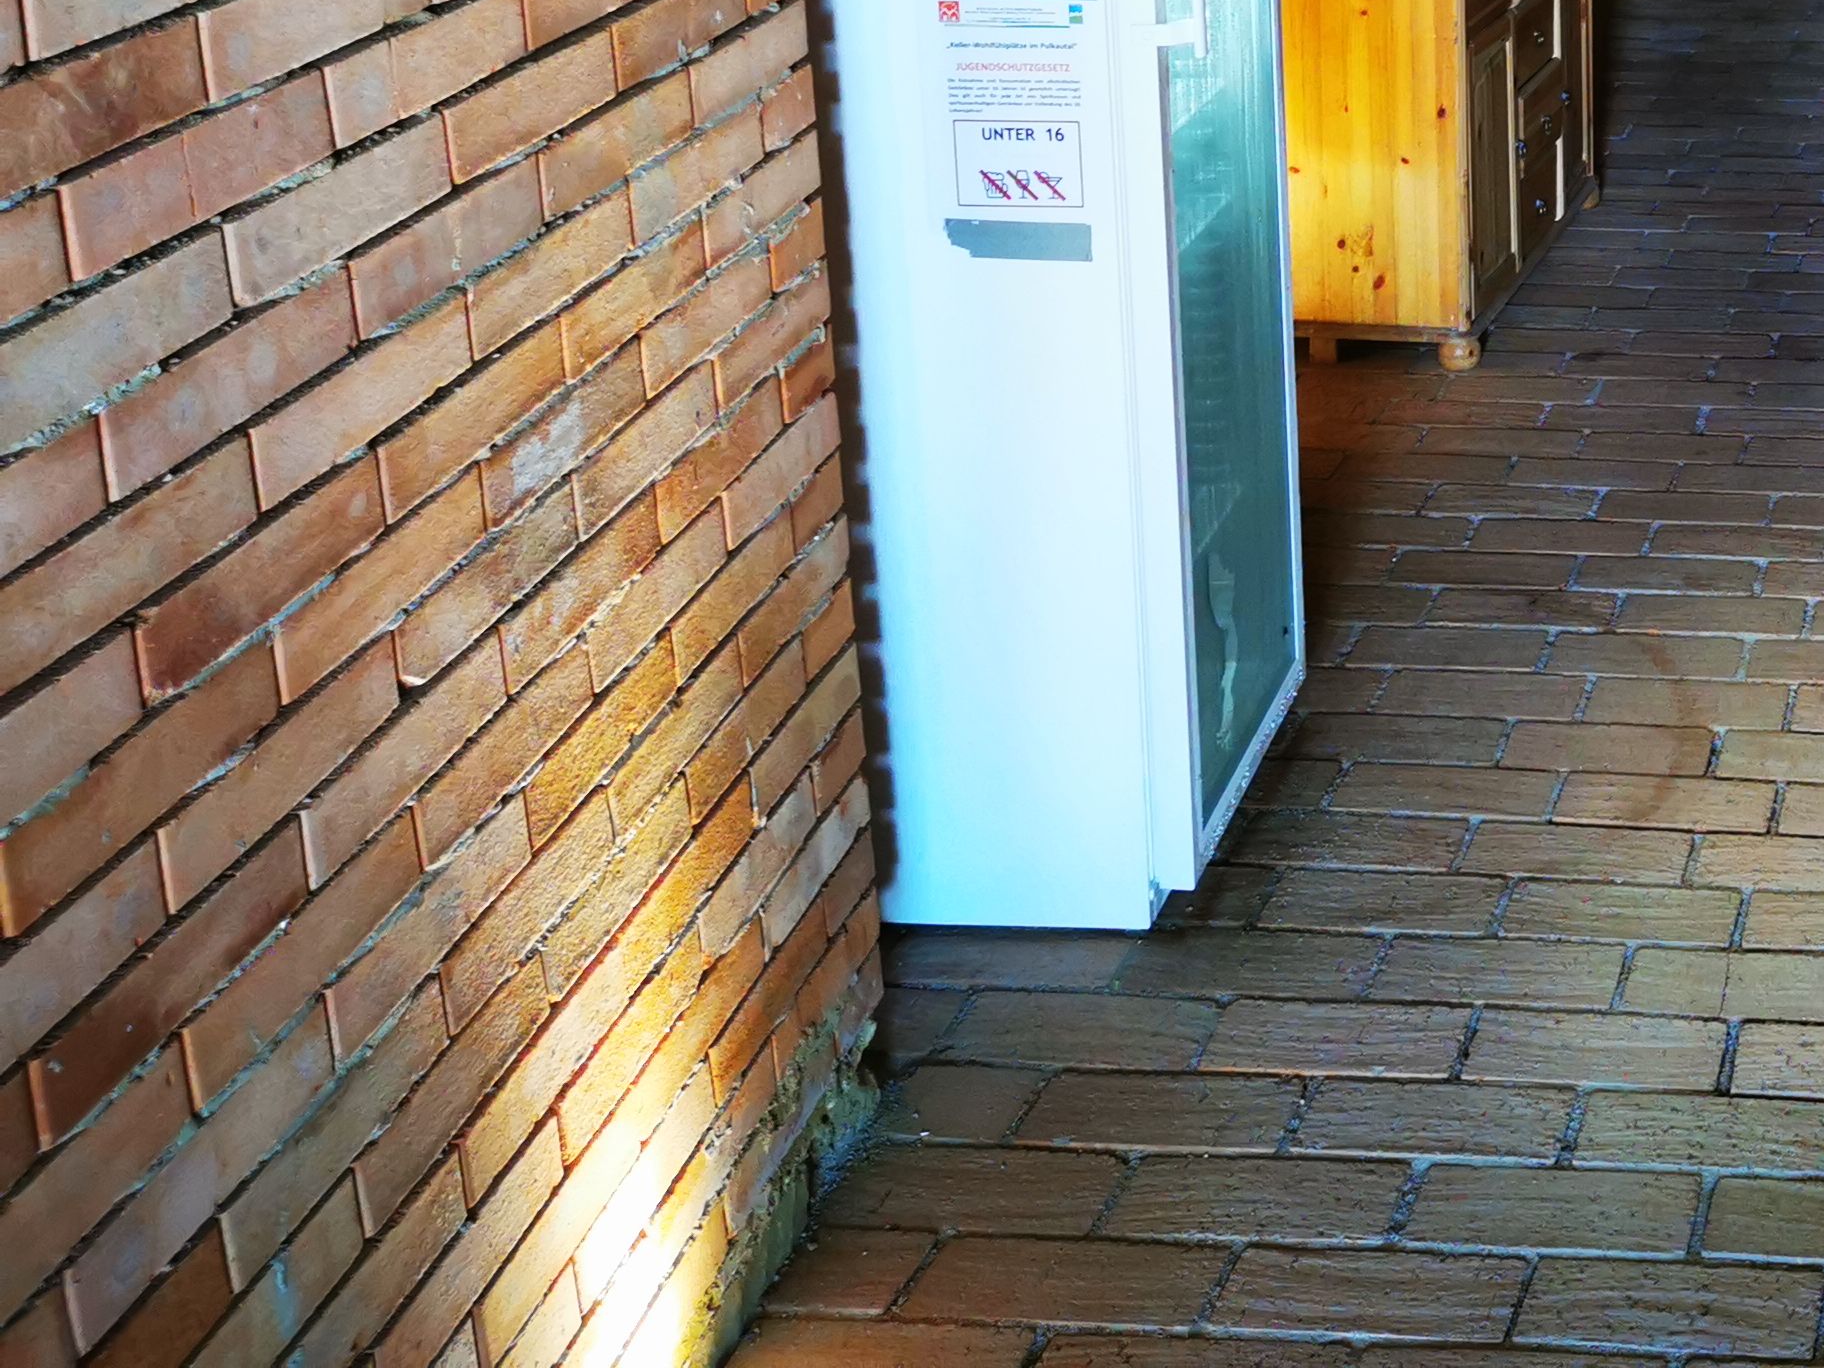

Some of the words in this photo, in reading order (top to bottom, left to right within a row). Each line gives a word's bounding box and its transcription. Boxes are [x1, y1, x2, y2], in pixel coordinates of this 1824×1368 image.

[955, 62, 1071, 73] JUGENDSCHUTZGESETZ
[981, 127, 1036, 141] UNTER
[1046, 127, 1065, 142] 16
